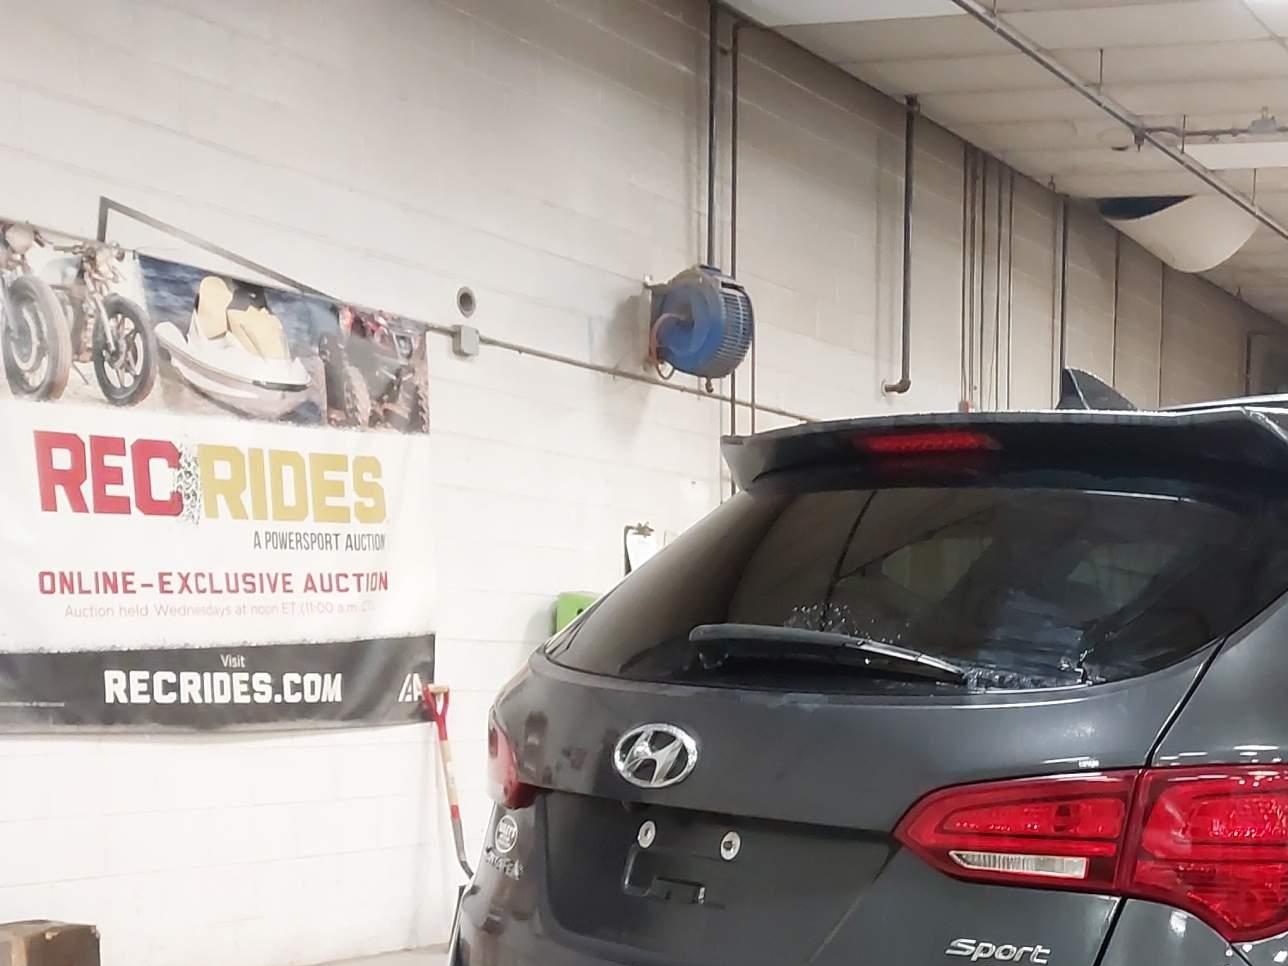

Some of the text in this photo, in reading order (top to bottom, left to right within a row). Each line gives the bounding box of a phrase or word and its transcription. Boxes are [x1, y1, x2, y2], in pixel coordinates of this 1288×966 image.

[33, 430, 387, 525] REC RIDES
[253, 532, 386, 552] A POWERSPORT AUCTION
[38, 570, 389, 595] ONLINE-EXCLUSIVE AUCTION
[65, 604, 115, 618] Auction
[119, 604, 149, 618] held
[153, 604, 232, 618] Wednesdays
[235, 604, 247, 616] at
[251, 606, 279, 616] noon
[282, 602, 297, 615] ET
[220, 655, 246, 668] Visit
[104, 670, 342, 704] RECRIDES.COM
[945, 938, 1051, 965] Sport
